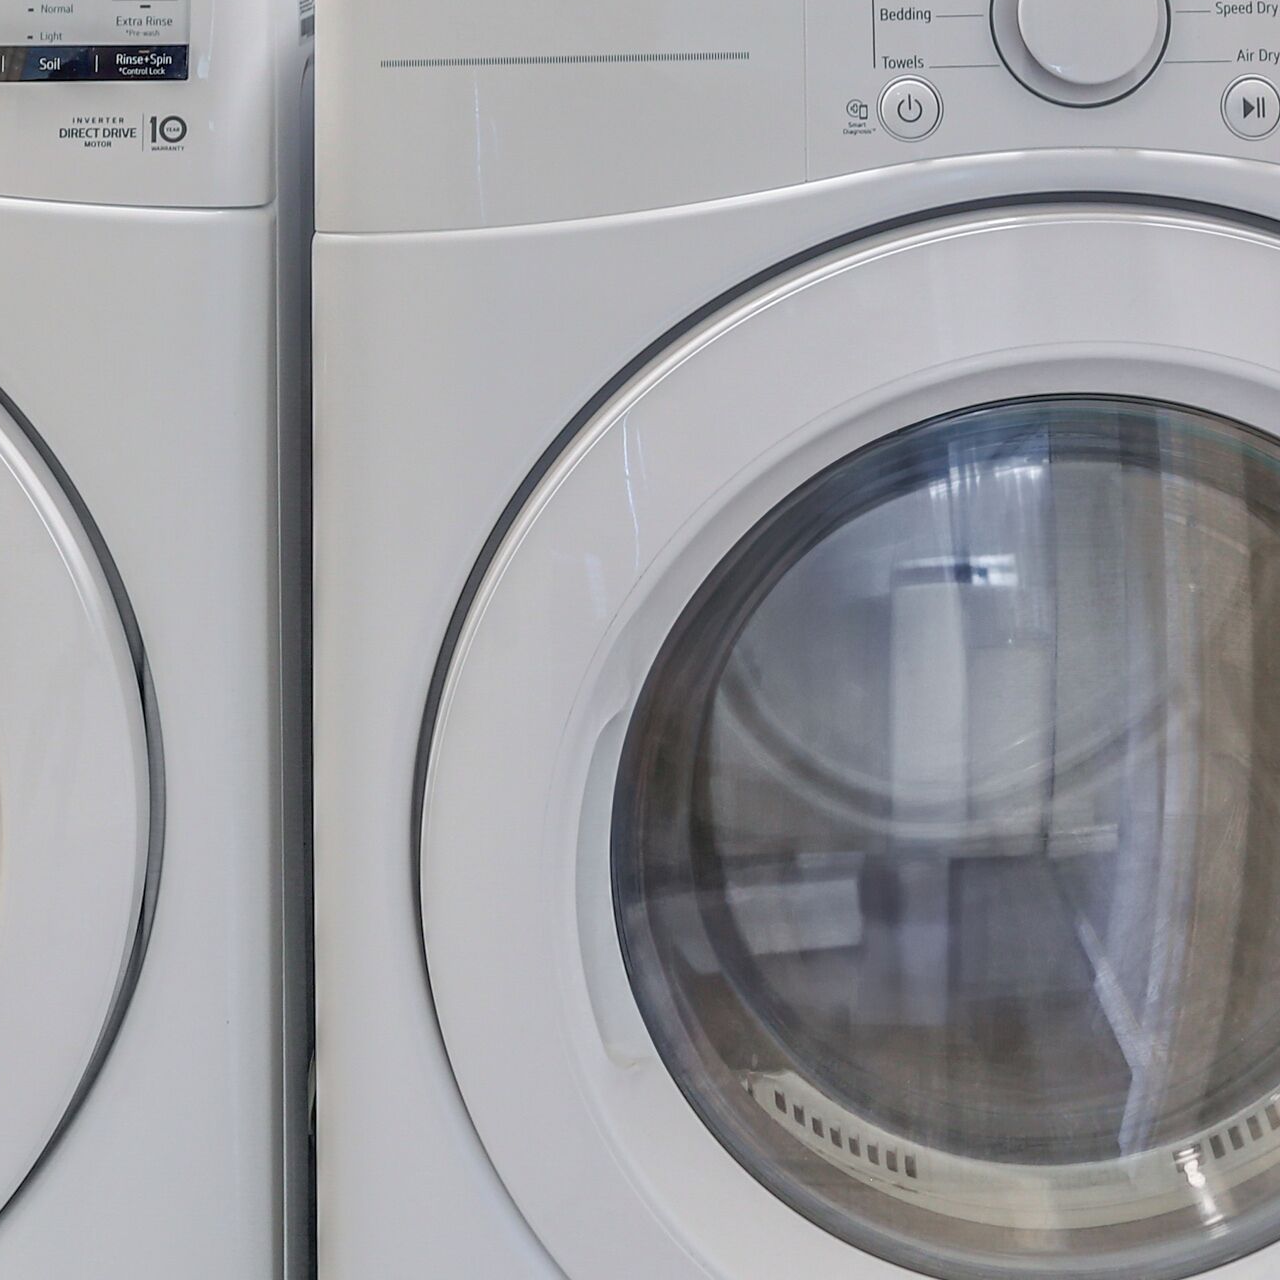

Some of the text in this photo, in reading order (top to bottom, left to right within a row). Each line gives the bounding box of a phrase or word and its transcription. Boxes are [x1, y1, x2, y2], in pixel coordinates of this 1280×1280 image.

[41, 4, 73, 13] Normal
[1215, 1, 1278, 18] Speed Dry
[116, 16, 172, 26] Extra Rinse
[879, 7, 932, 24] Bedding
[40, 32, 62, 42] Light
[882, 56, 924, 70] Towels
[1236, 49, 1280, 65] Air Dry
[39, 58, 60, 70] Soil
[149, 67, 165, 75] Lock
[59, 128, 136, 138] DIRECT DRIVE
[150, 116, 187, 143] 10
